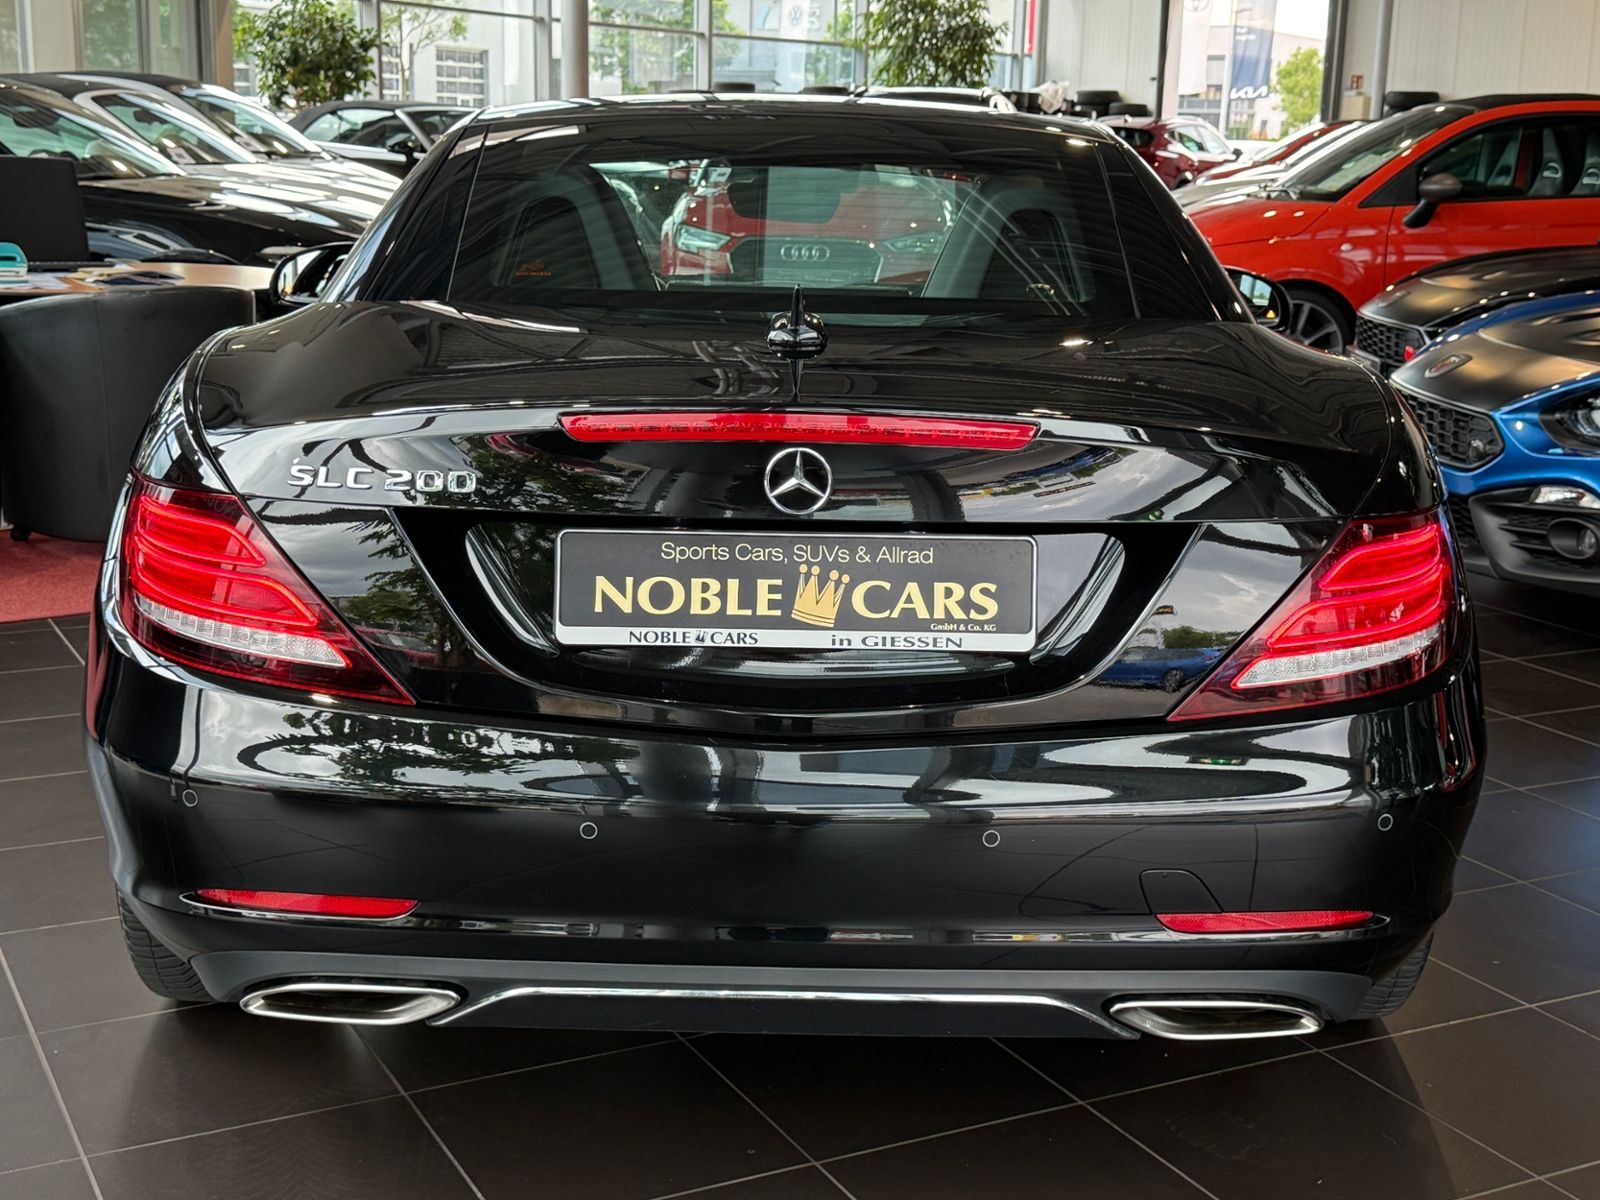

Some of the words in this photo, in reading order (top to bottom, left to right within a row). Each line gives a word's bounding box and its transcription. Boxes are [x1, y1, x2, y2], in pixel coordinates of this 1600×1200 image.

[287, 464, 374, 489] SLC
[383, 469, 477, 493] 200
[660, 541, 730, 563] Sports
[735, 543, 788, 564] Cars,
[793, 544, 850, 563] SUVs
[855, 546, 872, 563] &
[876, 545, 934, 565] Allrad
[594, 575, 783, 616] NOBLE
[851, 580, 999, 620] CARS
[930, 622, 957, 631] GmbH
[958, 623, 966, 631] &
[967, 623, 982, 631] Co.
[983, 624, 997, 632] KG
[629, 630, 691, 645] NOBLE
[710, 631, 758, 646] CARS
[831, 634, 852, 647] in
[861, 635, 963, 649] GIESSEN
